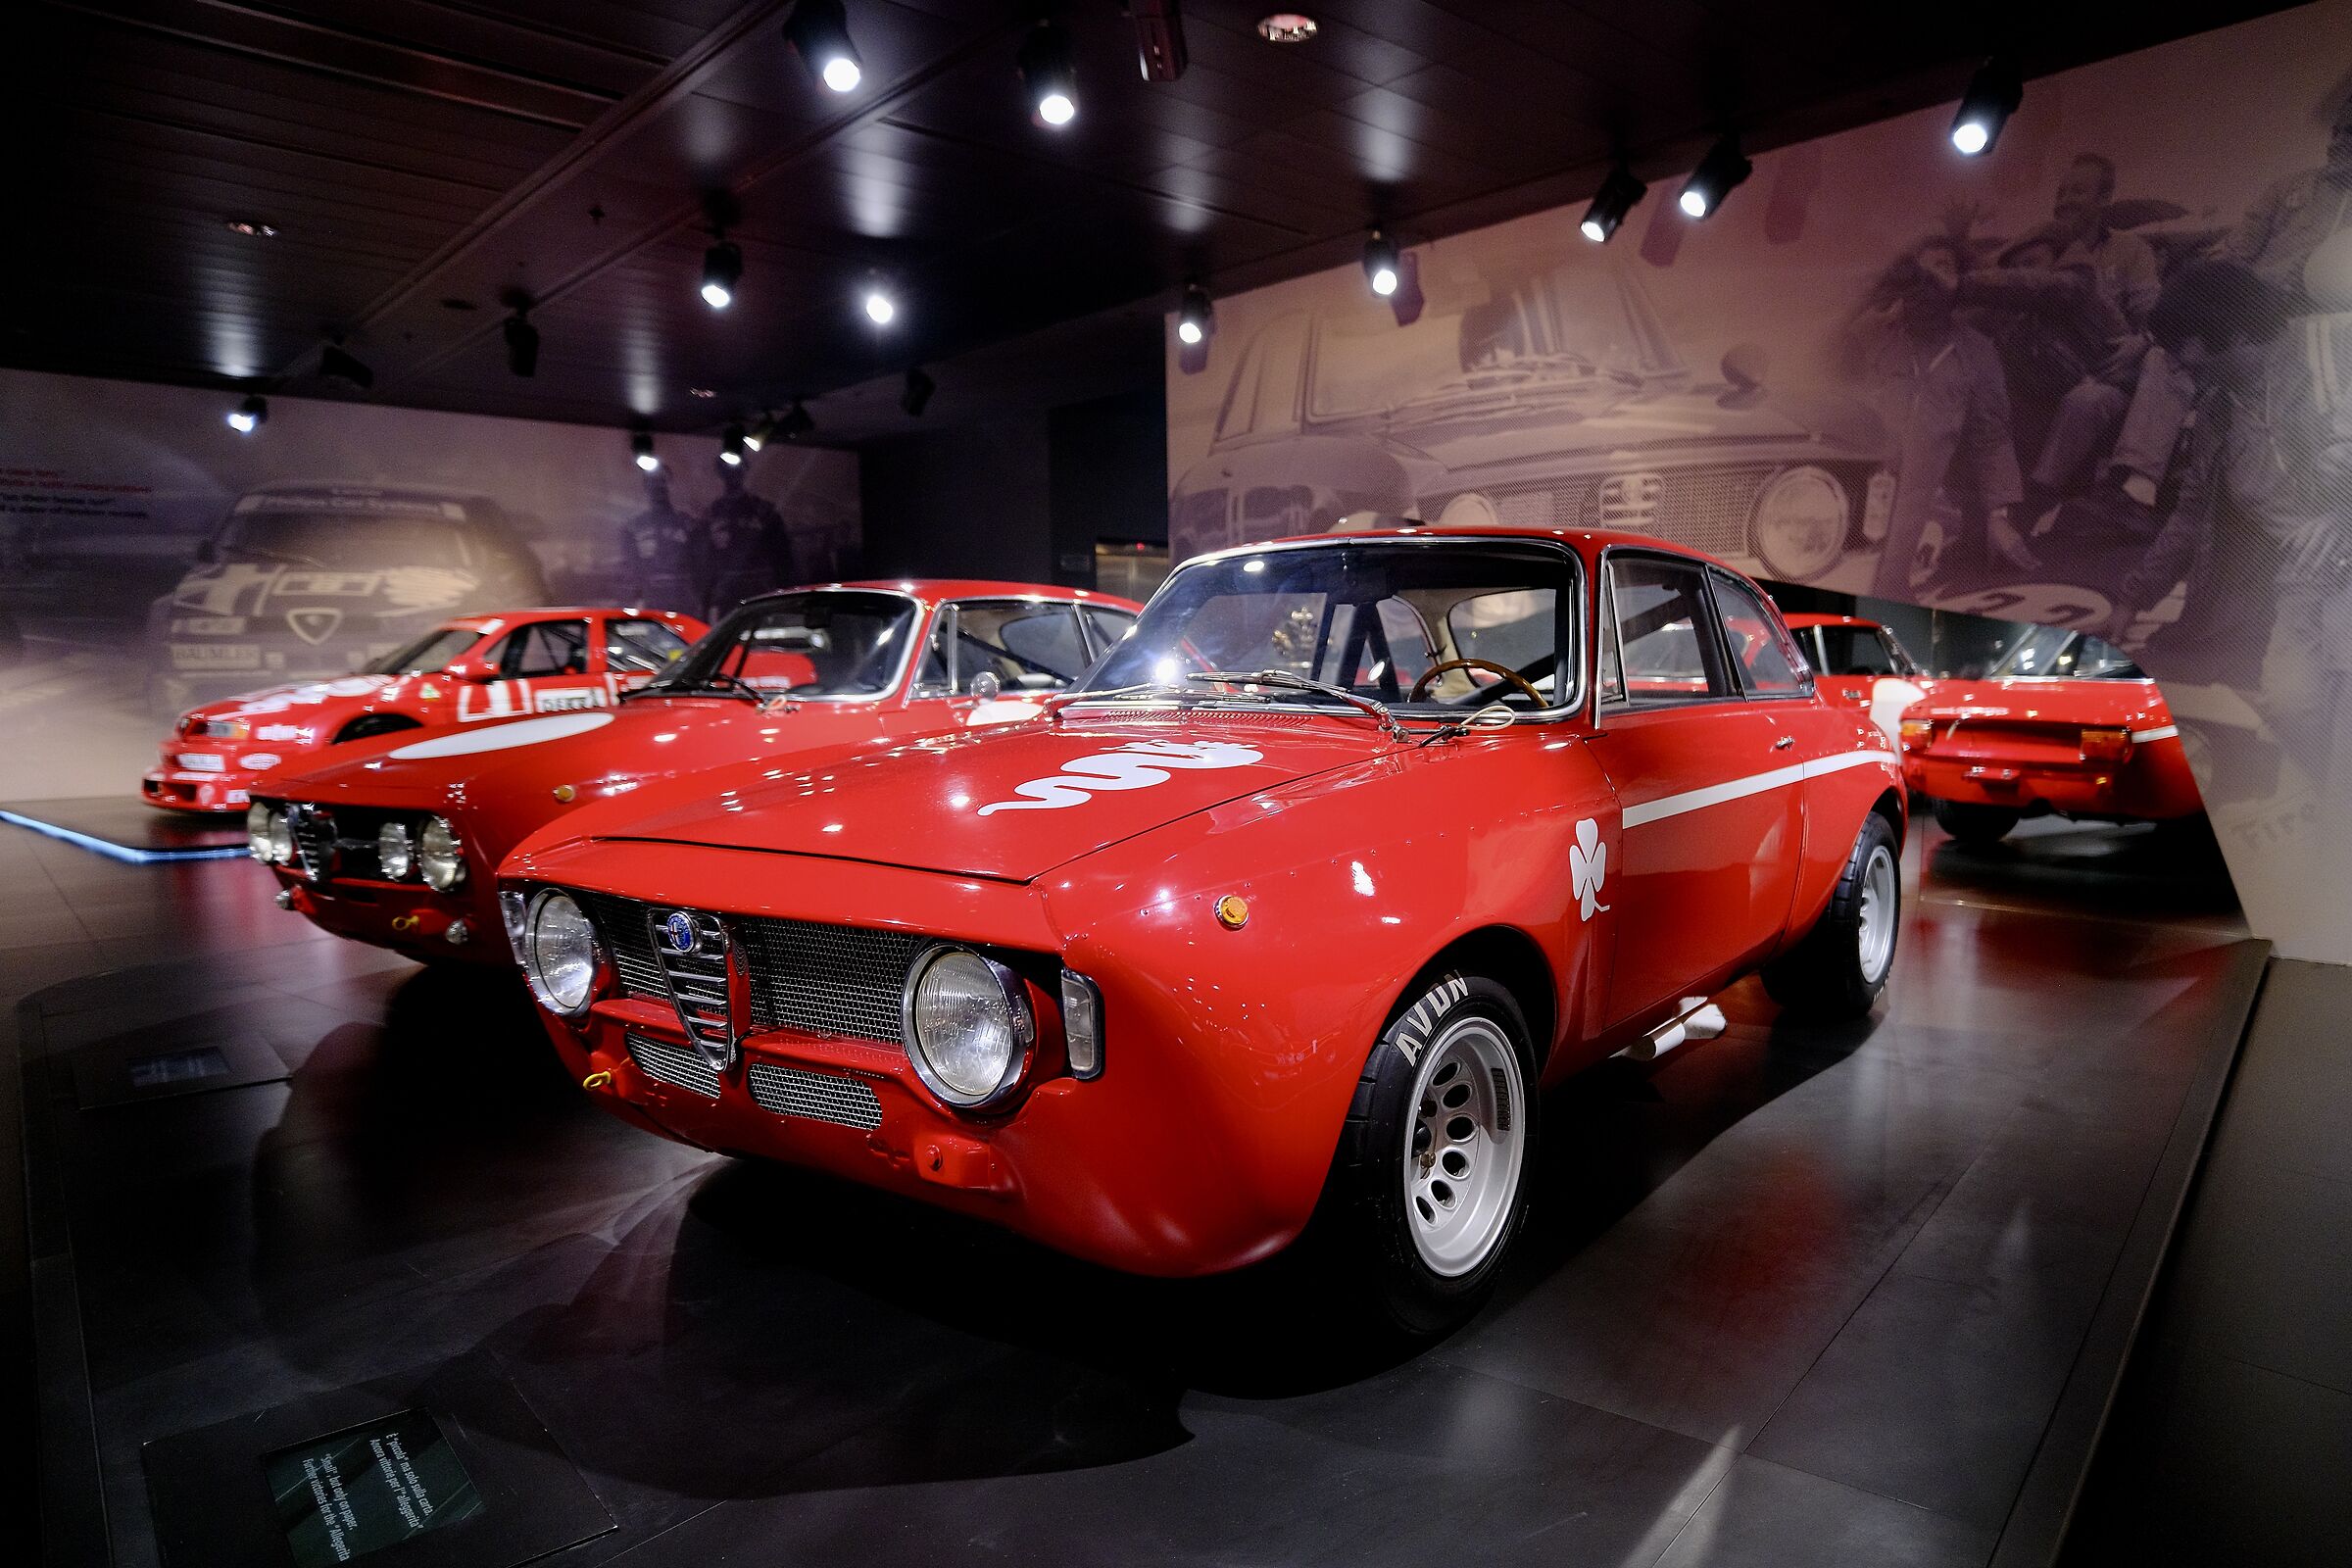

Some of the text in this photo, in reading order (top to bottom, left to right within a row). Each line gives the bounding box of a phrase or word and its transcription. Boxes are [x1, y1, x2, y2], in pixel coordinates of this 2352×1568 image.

[1395, 970, 1469, 1067] AVON
[369, 1438, 385, 1458] Ancora
[302, 1457, 320, 1480] Further
[378, 1456, 397, 1479] vittorie
[328, 1475, 343, 1489] but
[384, 1477, 401, 1489] per
[404, 1471, 419, 1485] solo
[310, 1478, 328, 1505] victories
[332, 1487, 349, 1501] only
[411, 1483, 427, 1499] sulla
[319, 1502, 333, 1514] for
[323, 1513, 337, 1526] the
